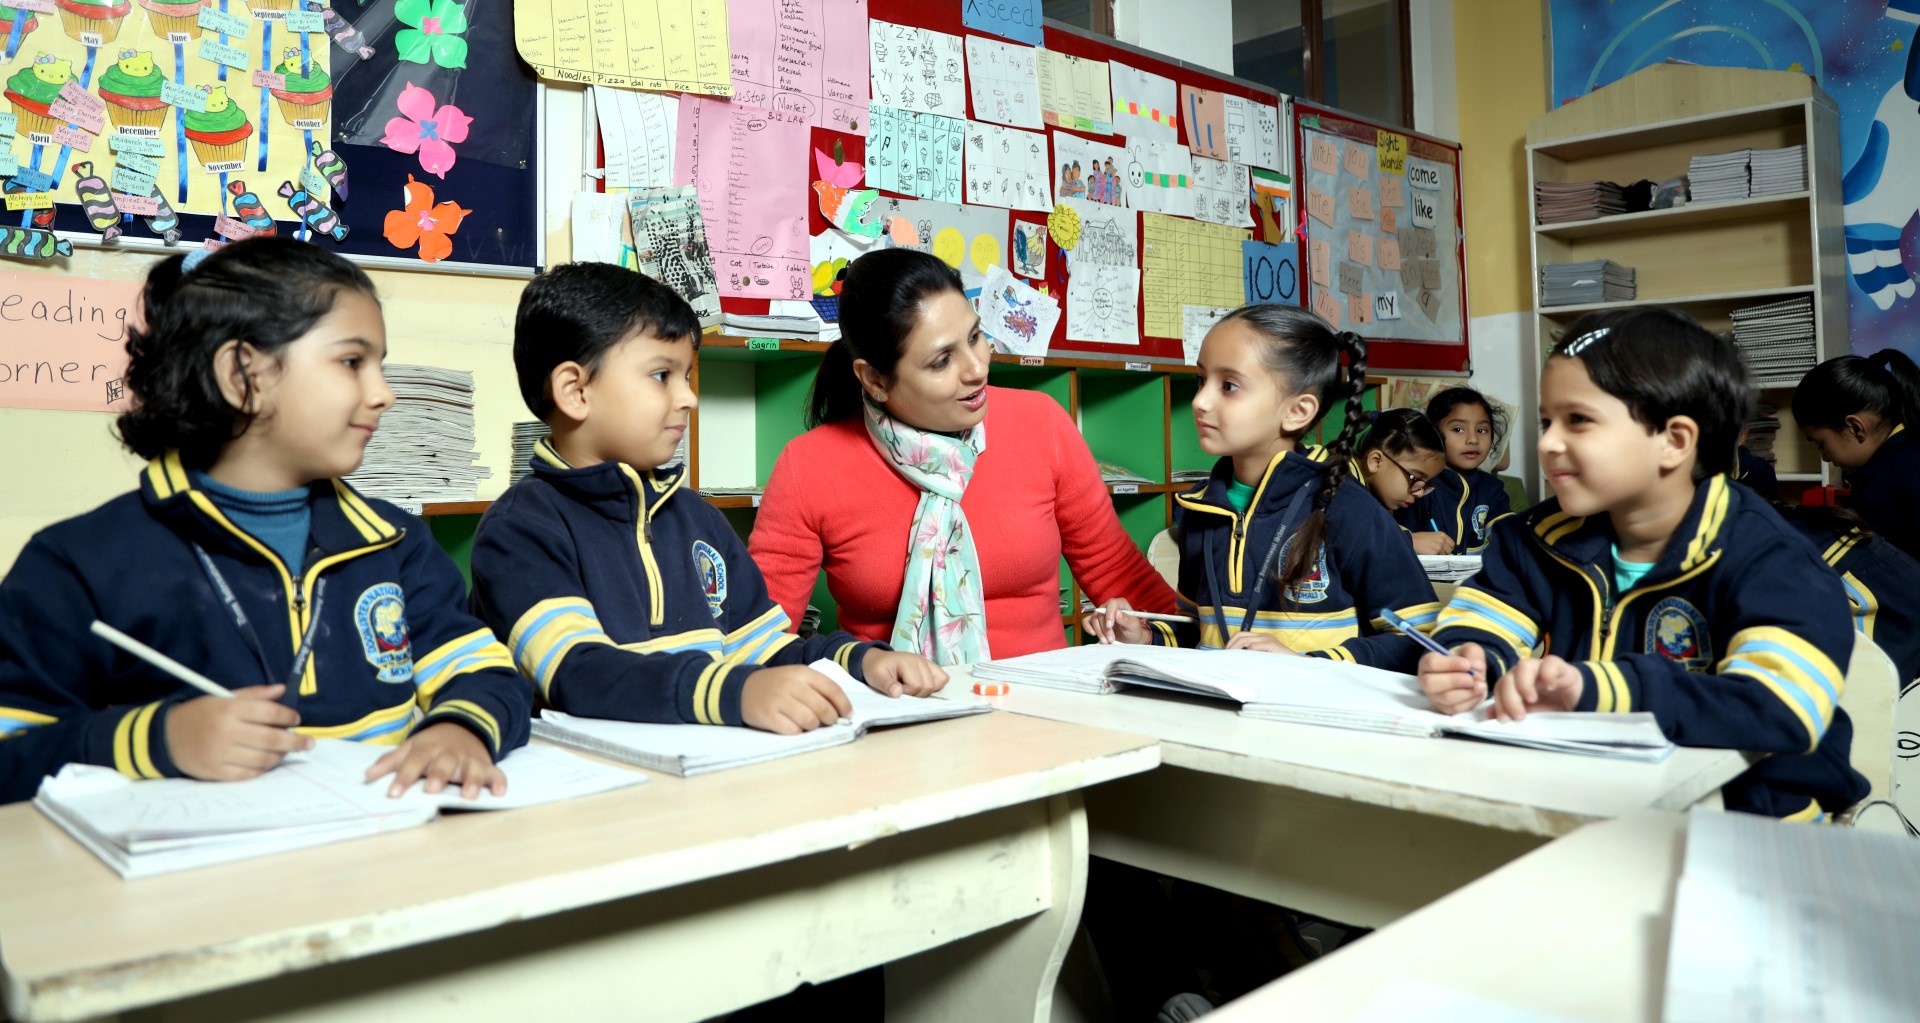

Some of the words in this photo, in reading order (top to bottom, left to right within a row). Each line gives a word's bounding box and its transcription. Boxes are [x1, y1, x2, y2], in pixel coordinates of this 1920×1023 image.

[84, 36, 98, 45] May
[171, 34, 188, 42] June
[557, 69, 591, 82] Noodles
[597, 74, 625, 84] Pizza
[674, 82, 690, 91] Rice
[731, 90, 766, 107] us-Stop
[777, 96, 807, 114] Market
[296, 120, 321, 128] October
[832, 107, 859, 124] School
[29, 133, 50, 143] April
[119, 126, 157, 136] December
[1379, 132, 1400, 152] Sight
[208, 162, 242, 171] November
[1380, 155, 1403, 170] Words
[1410, 166, 1438, 184] come
[1414, 197, 1434, 220] like
[730, 259, 743, 268] Cat
[1248, 256, 1297, 302] 100
[1378, 295, 1394, 315] my
[716, 563, 725, 591] SCHOOL
